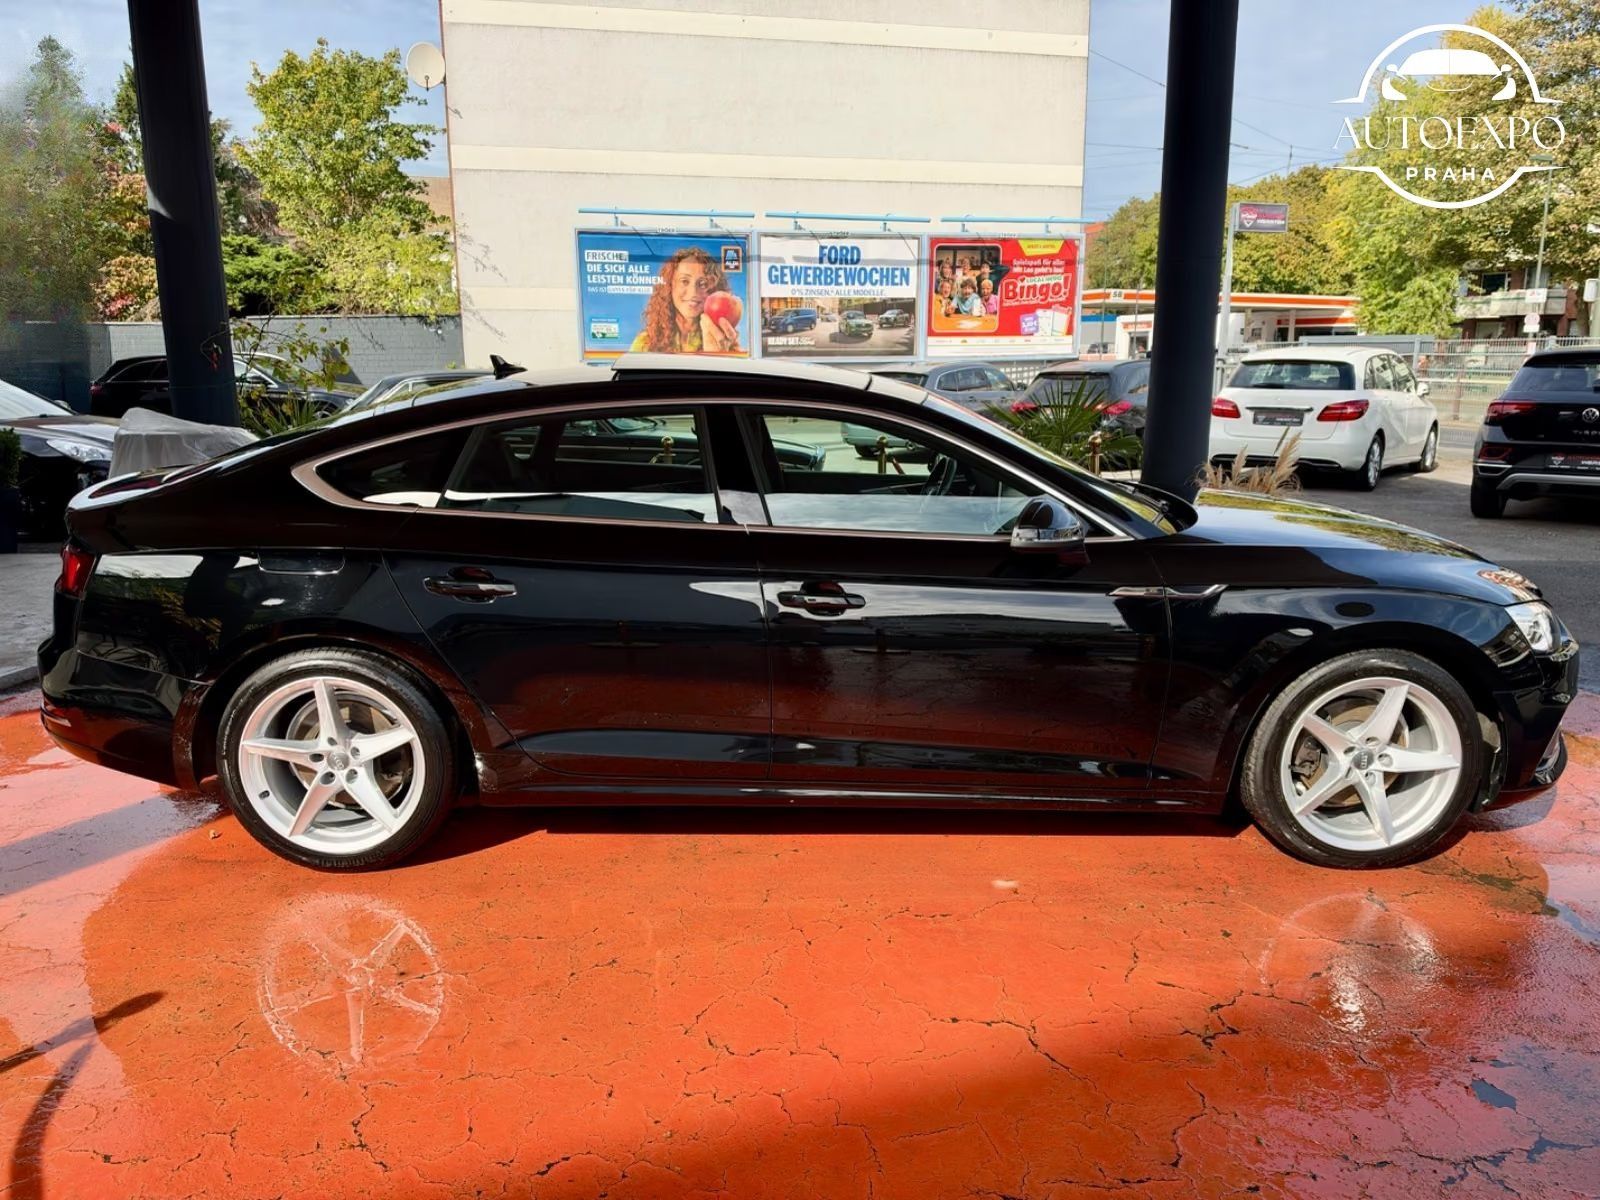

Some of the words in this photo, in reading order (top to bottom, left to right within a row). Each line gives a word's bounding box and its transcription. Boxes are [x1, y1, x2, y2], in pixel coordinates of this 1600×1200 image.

[818, 245, 861, 265] FORD
[586, 264, 602, 273] DIE
[604, 264, 625, 273] SICH
[628, 265, 650, 274] ALLE
[587, 274, 623, 284] LEISTEN
[768, 265, 910, 287] GEWERBEWOCHEN
[1004, 274, 1071, 303] Bingo!
